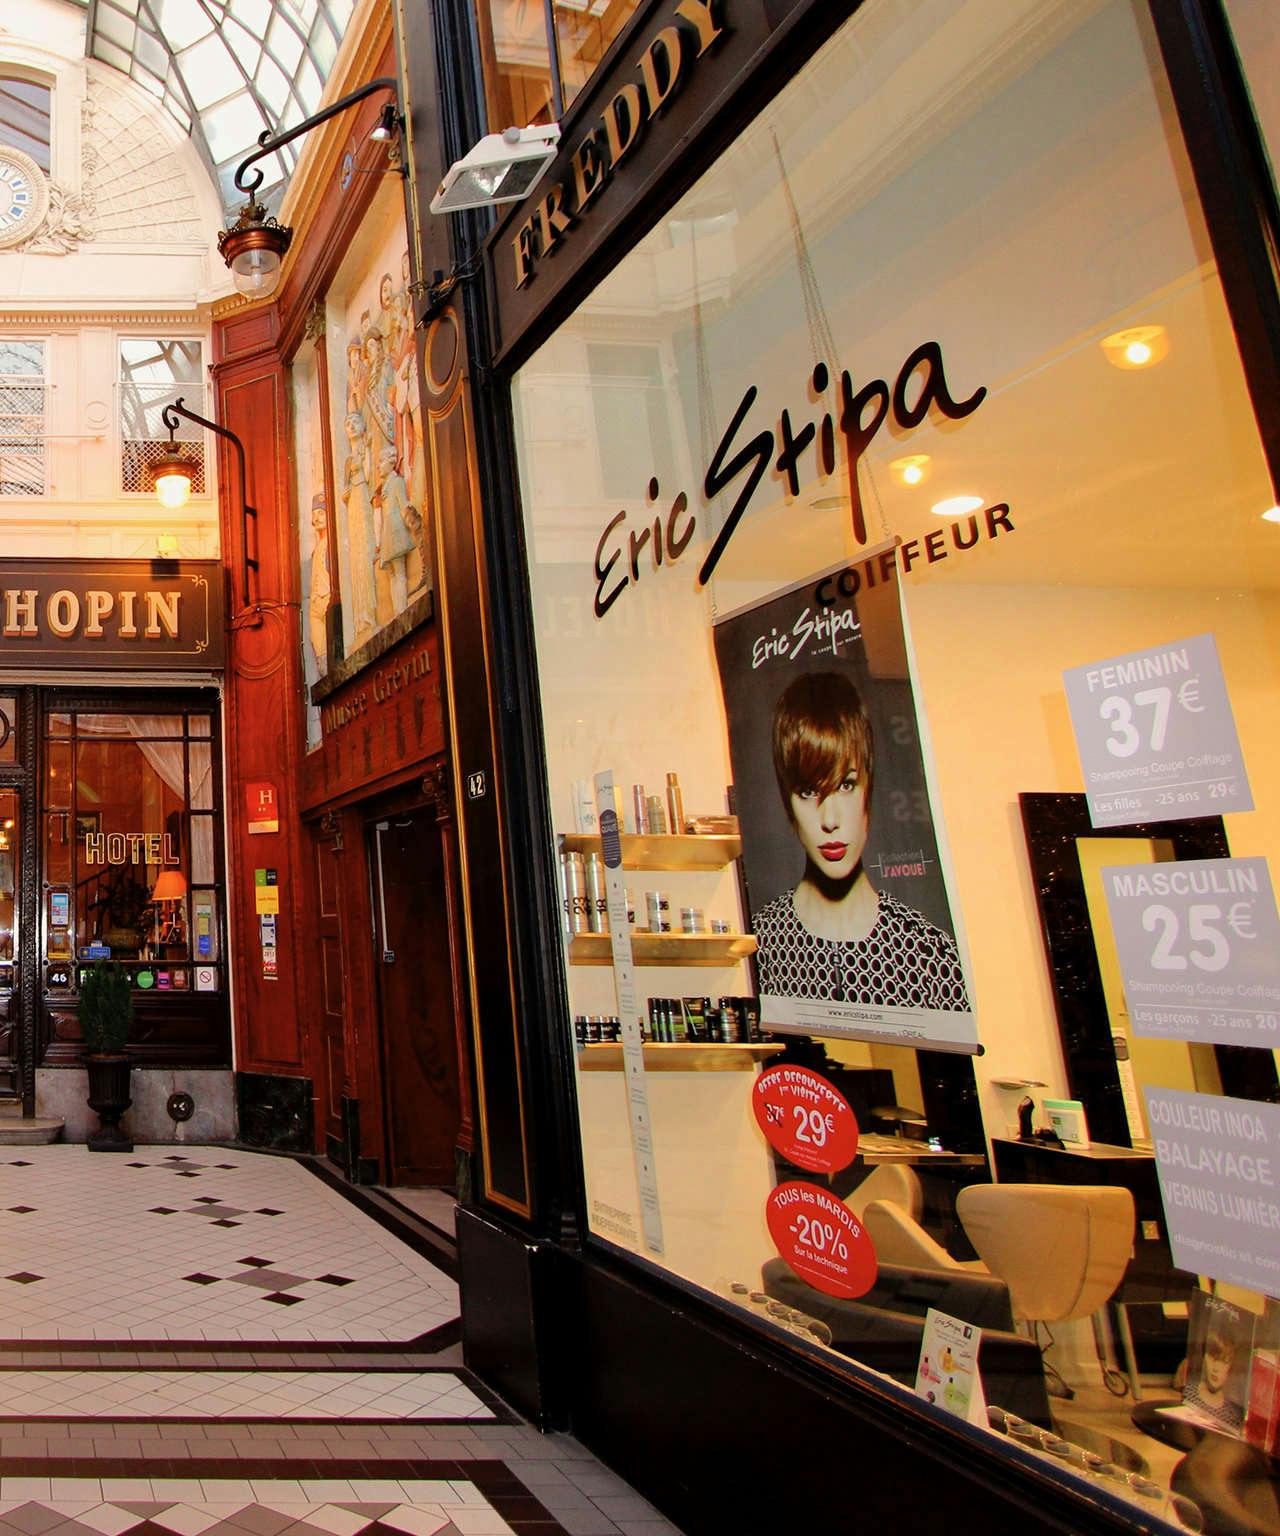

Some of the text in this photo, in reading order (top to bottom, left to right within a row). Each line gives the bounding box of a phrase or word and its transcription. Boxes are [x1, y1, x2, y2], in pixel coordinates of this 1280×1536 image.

[511, 0, 723, 291] FREDDY
[594, 341, 988, 619] Eric Stipa
[814, 502, 1016, 608] COIFFEUR
[752, 627, 790, 669] Eric
[790, 607, 861, 660] Stipa
[371, 645, 432, 703] Grévin
[1086, 649, 1191, 693] FEMININ
[259, 789, 273, 805] H
[470, 774, 484, 796] 42
[1178, 791, 1200, 803] ans
[85, 832, 180, 865] HOTEL
[882, 863, 924, 879] J'AVOUE
[1112, 867, 1258, 898] MASCULIN
[51, 972, 68, 984] 46
[1149, 1098, 1269, 1144] COULEUR INOA
[1157, 1139, 1275, 1187] BALAYAGE
[774, 1188, 861, 1239] TOUS les MARDIS
[1162, 1179, 1219, 1216] VERNIS
[789, 1214, 849, 1261] -20%
[793, 1244, 807, 1258] Sur
